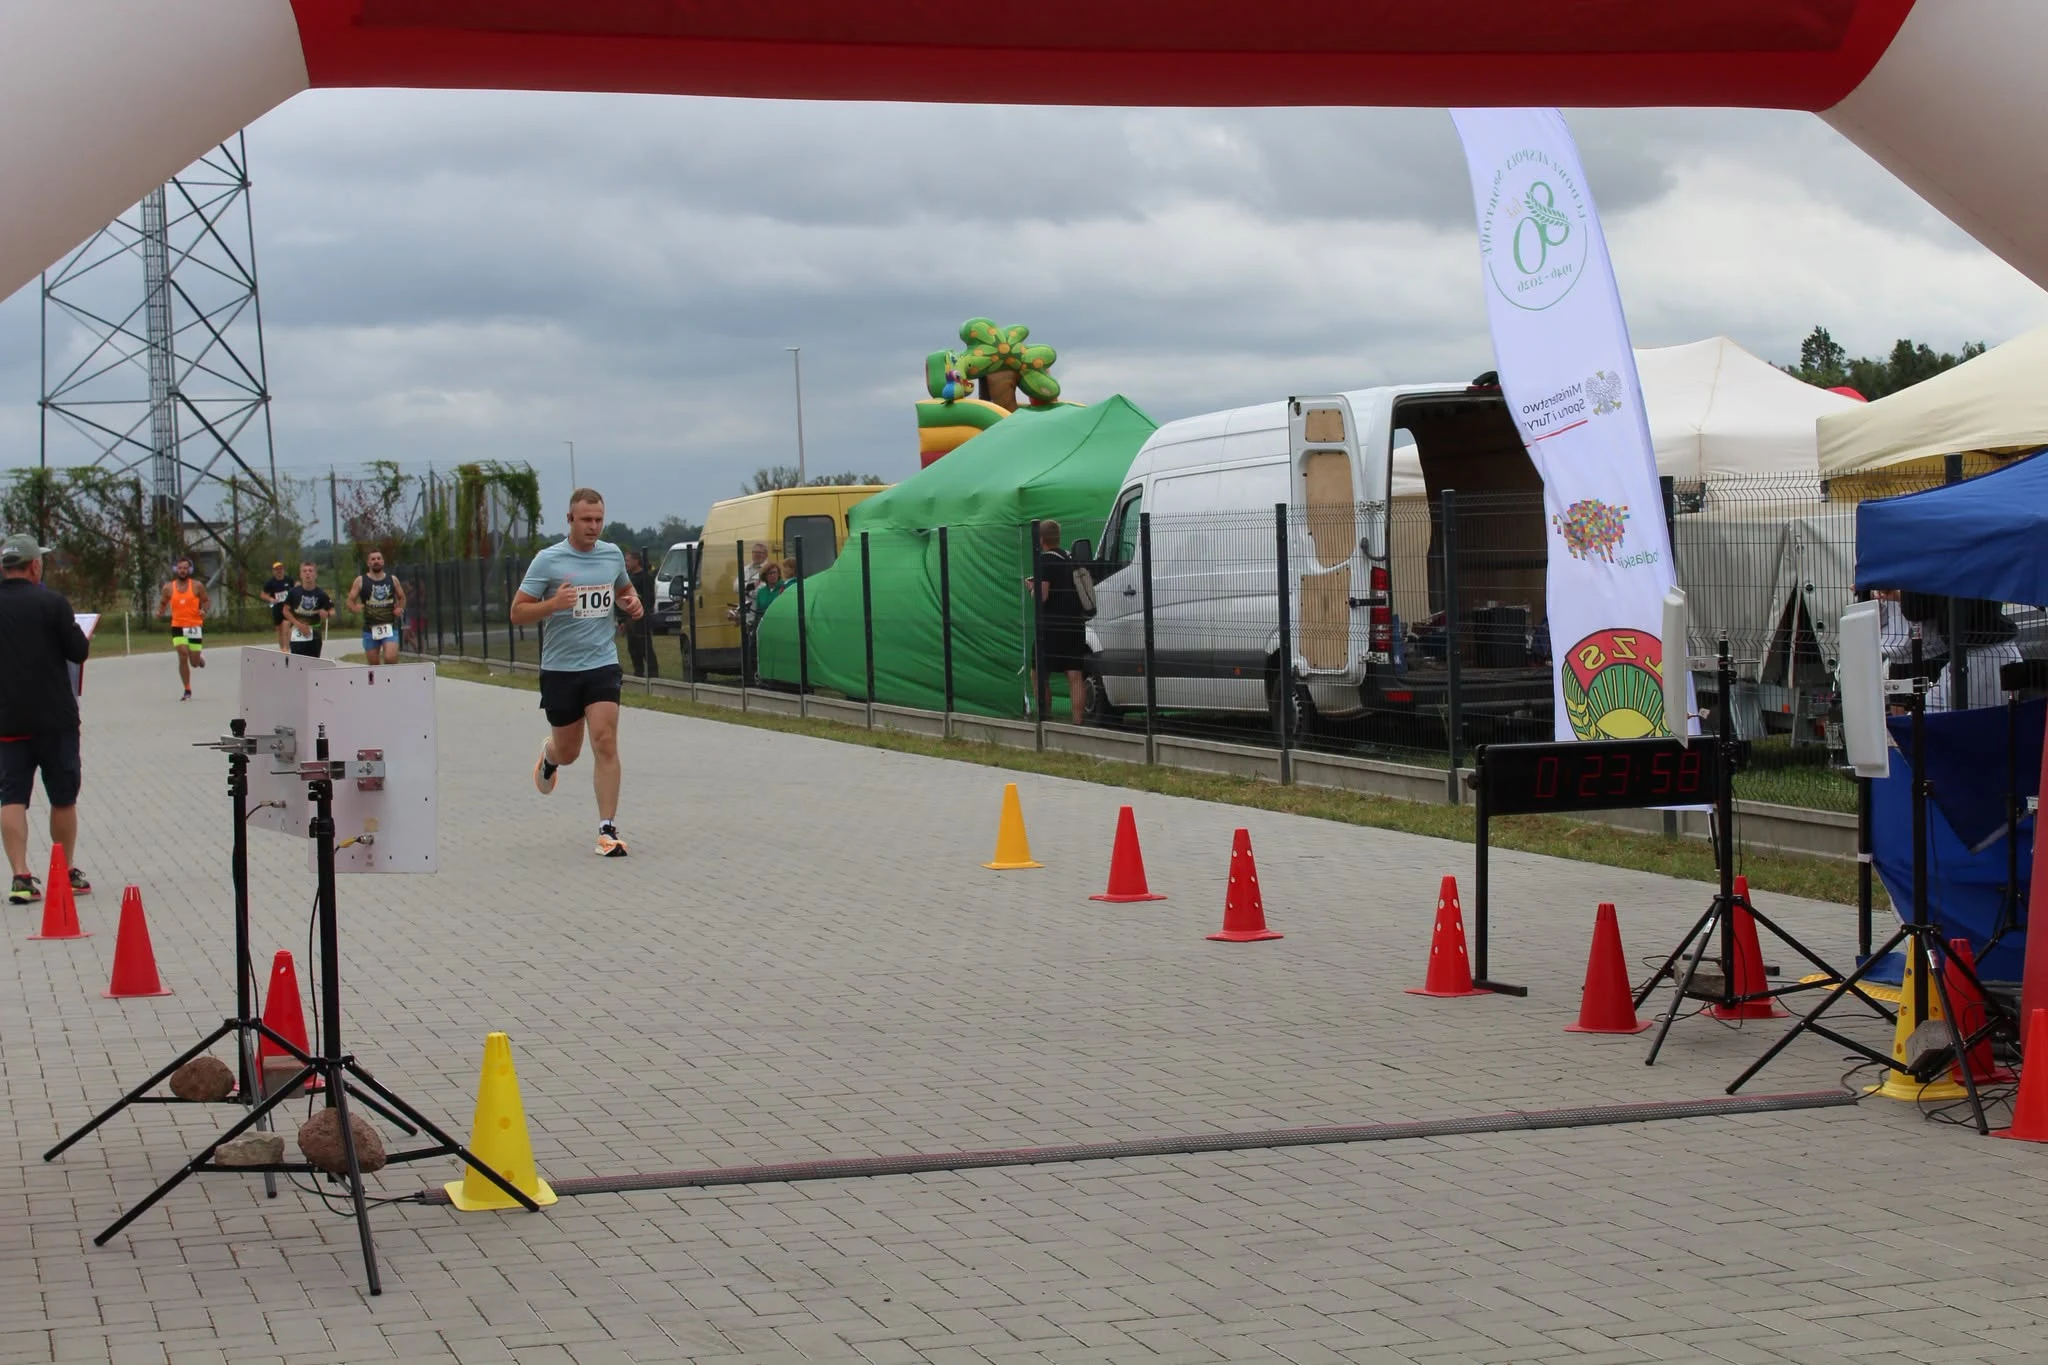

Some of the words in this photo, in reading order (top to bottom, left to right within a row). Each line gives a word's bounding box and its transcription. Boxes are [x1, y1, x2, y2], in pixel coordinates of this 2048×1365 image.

[579, 590, 611, 609] 106
[376, 625, 388, 635] 31
[1534, 751, 1701, 798] 0:23:58
